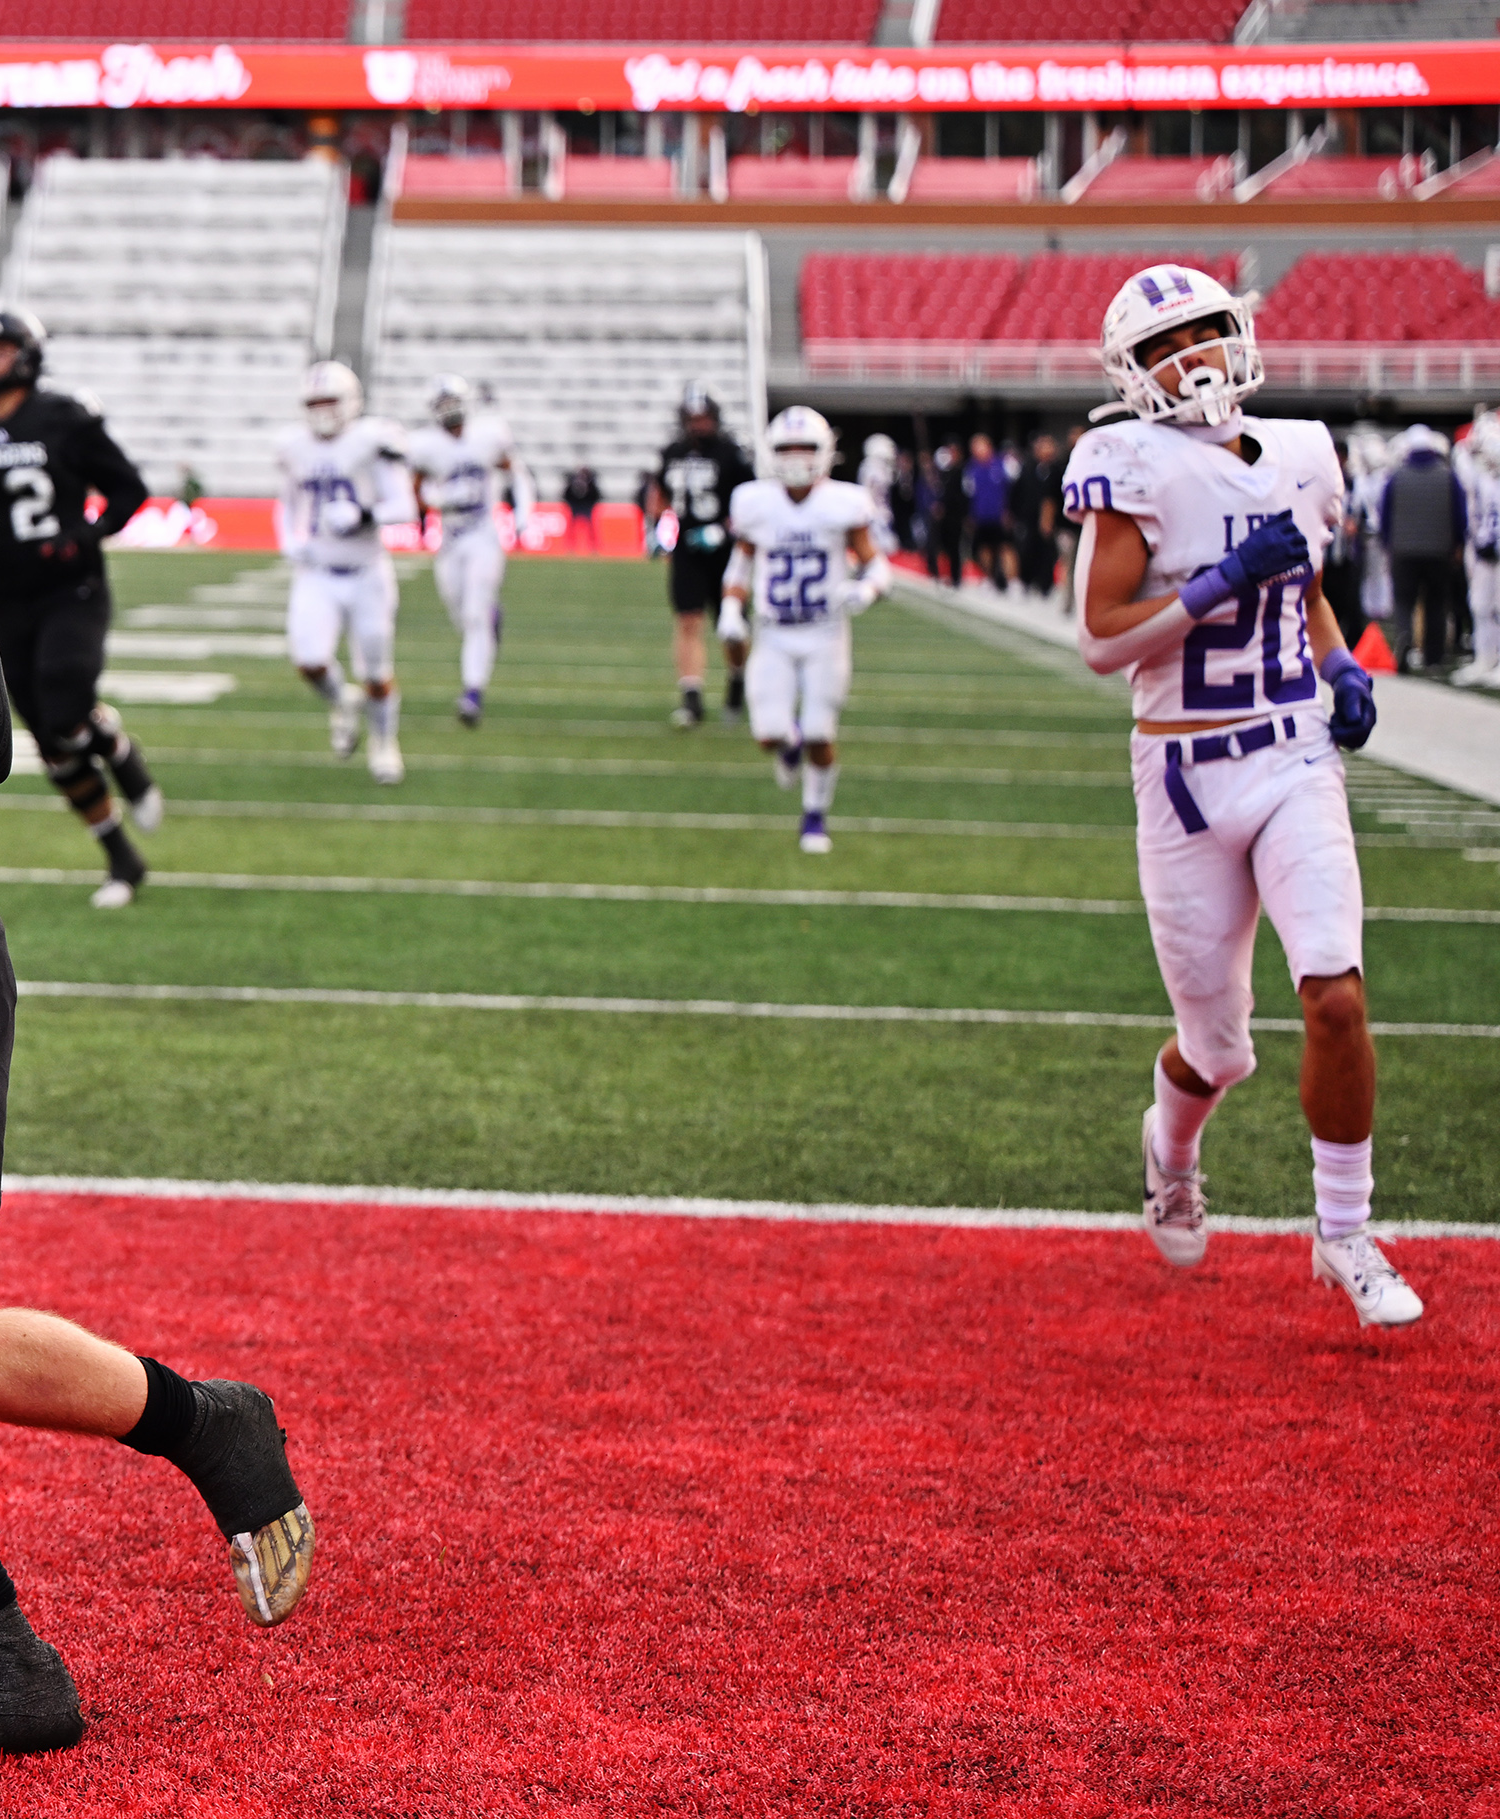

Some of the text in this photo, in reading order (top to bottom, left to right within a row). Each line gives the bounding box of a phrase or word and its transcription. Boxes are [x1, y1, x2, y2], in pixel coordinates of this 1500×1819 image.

[970, 61, 1035, 102] the
[768, 550, 827, 607] 22
[1183, 564, 1316, 709] 20
